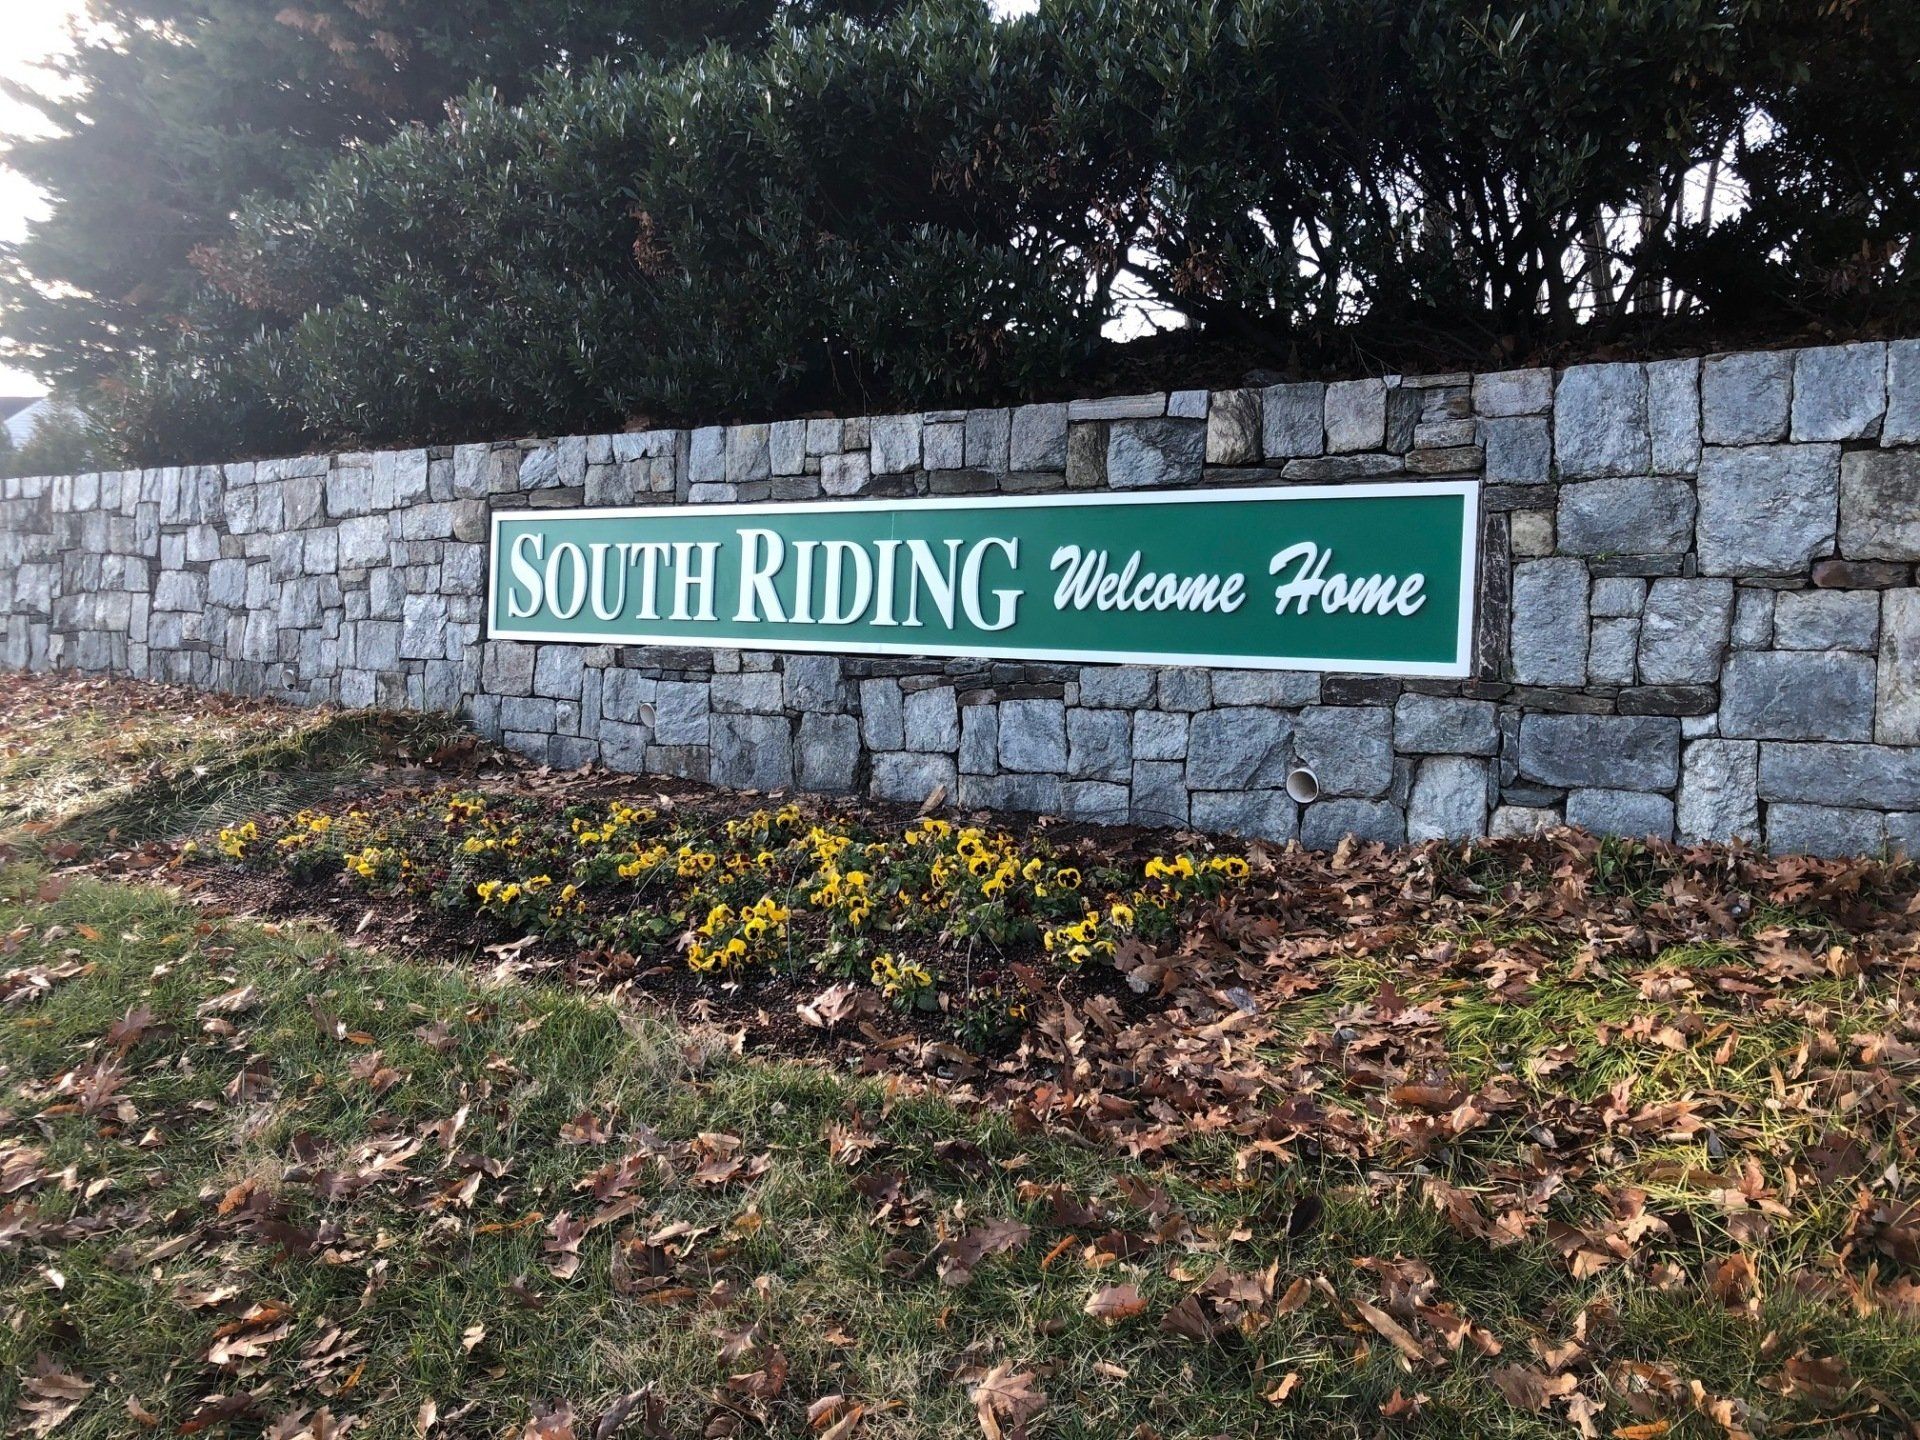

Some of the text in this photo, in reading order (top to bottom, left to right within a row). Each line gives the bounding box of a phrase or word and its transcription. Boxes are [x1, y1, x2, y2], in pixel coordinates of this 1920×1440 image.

[507, 527, 1427, 632] SOUTH RIDING Welcome Home
